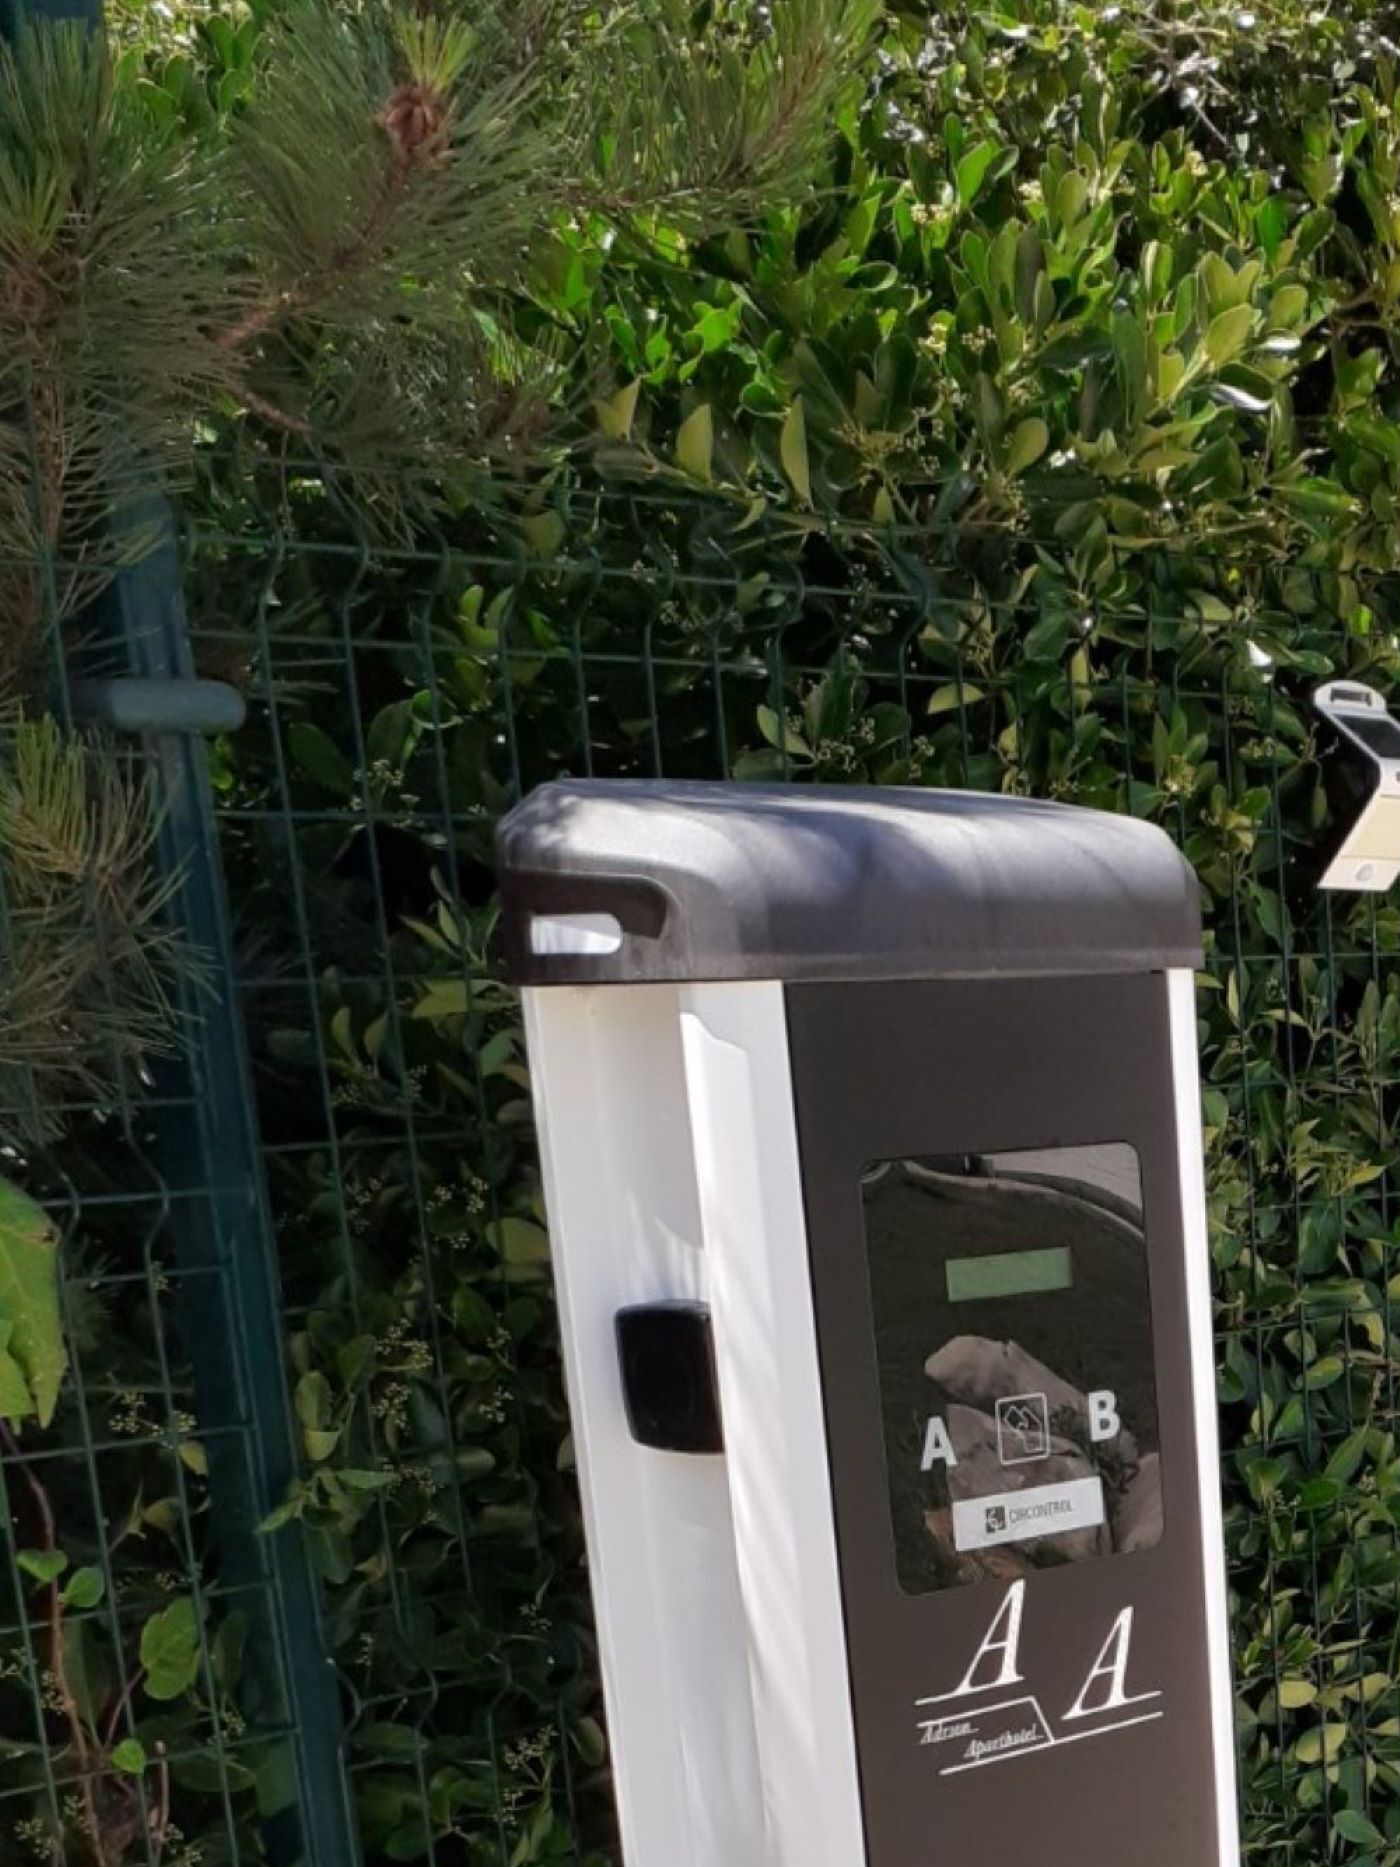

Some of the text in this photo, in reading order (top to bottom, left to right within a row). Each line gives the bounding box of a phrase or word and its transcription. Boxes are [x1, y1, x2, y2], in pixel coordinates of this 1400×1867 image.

[920, 1415, 958, 1472] A
[1087, 1388, 1121, 1443] B
[1008, 1498, 1074, 1525] CIRCONTROL
[951, 1578, 1134, 1720] A A
